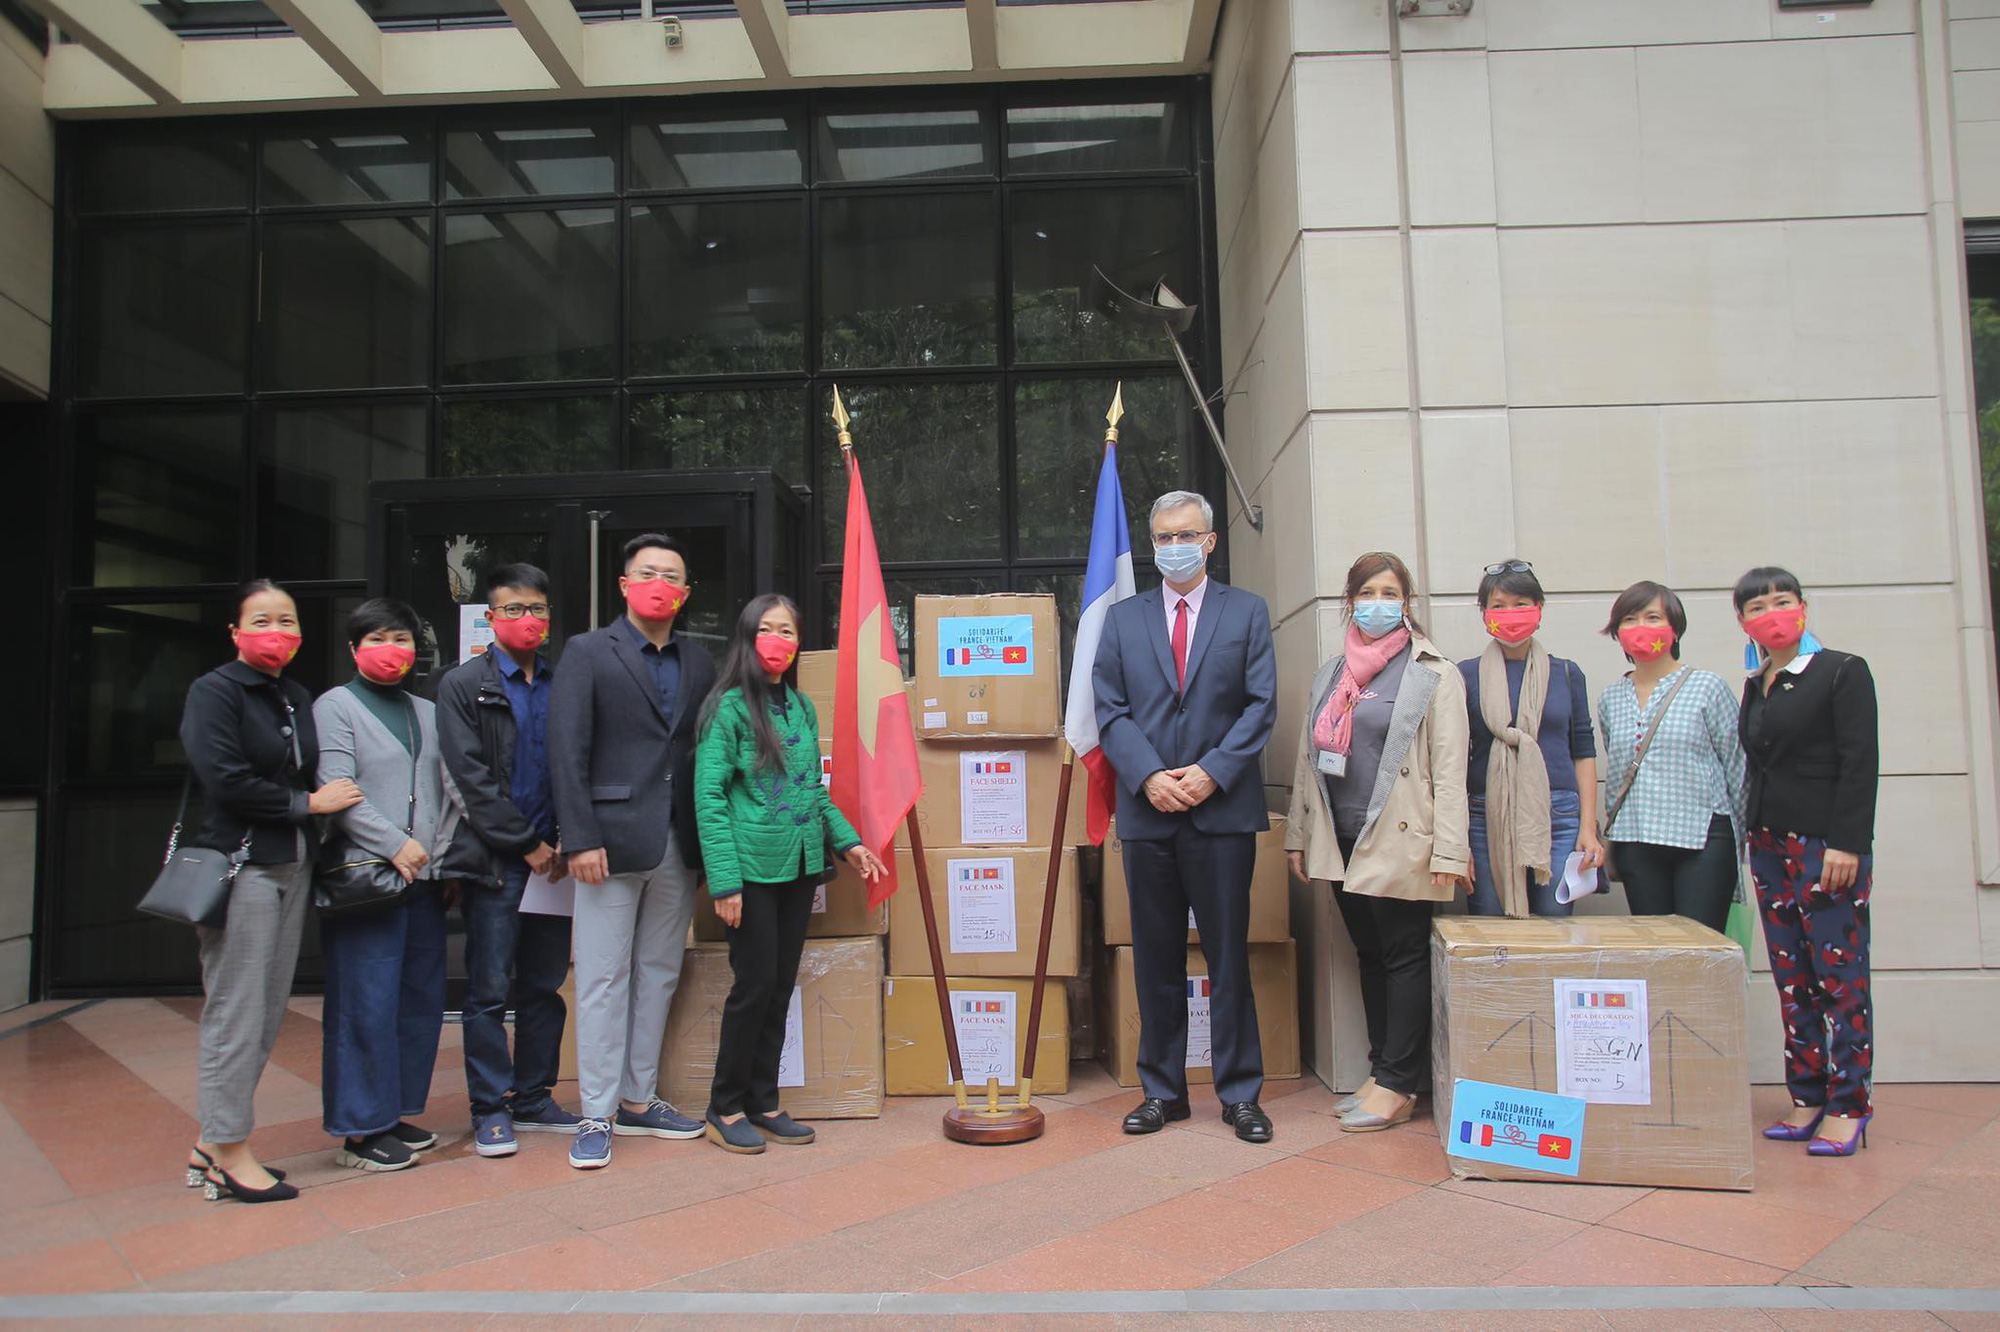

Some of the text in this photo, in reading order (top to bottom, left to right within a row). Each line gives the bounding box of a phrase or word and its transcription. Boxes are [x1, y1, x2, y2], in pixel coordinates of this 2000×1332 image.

[970, 777, 1017, 786] FACE SHIELD
[984, 929, 996, 940] 15
[1613, 1073, 1625, 1091] 5
[1480, 1109, 1555, 1130] FRANCE-VIETNAM
